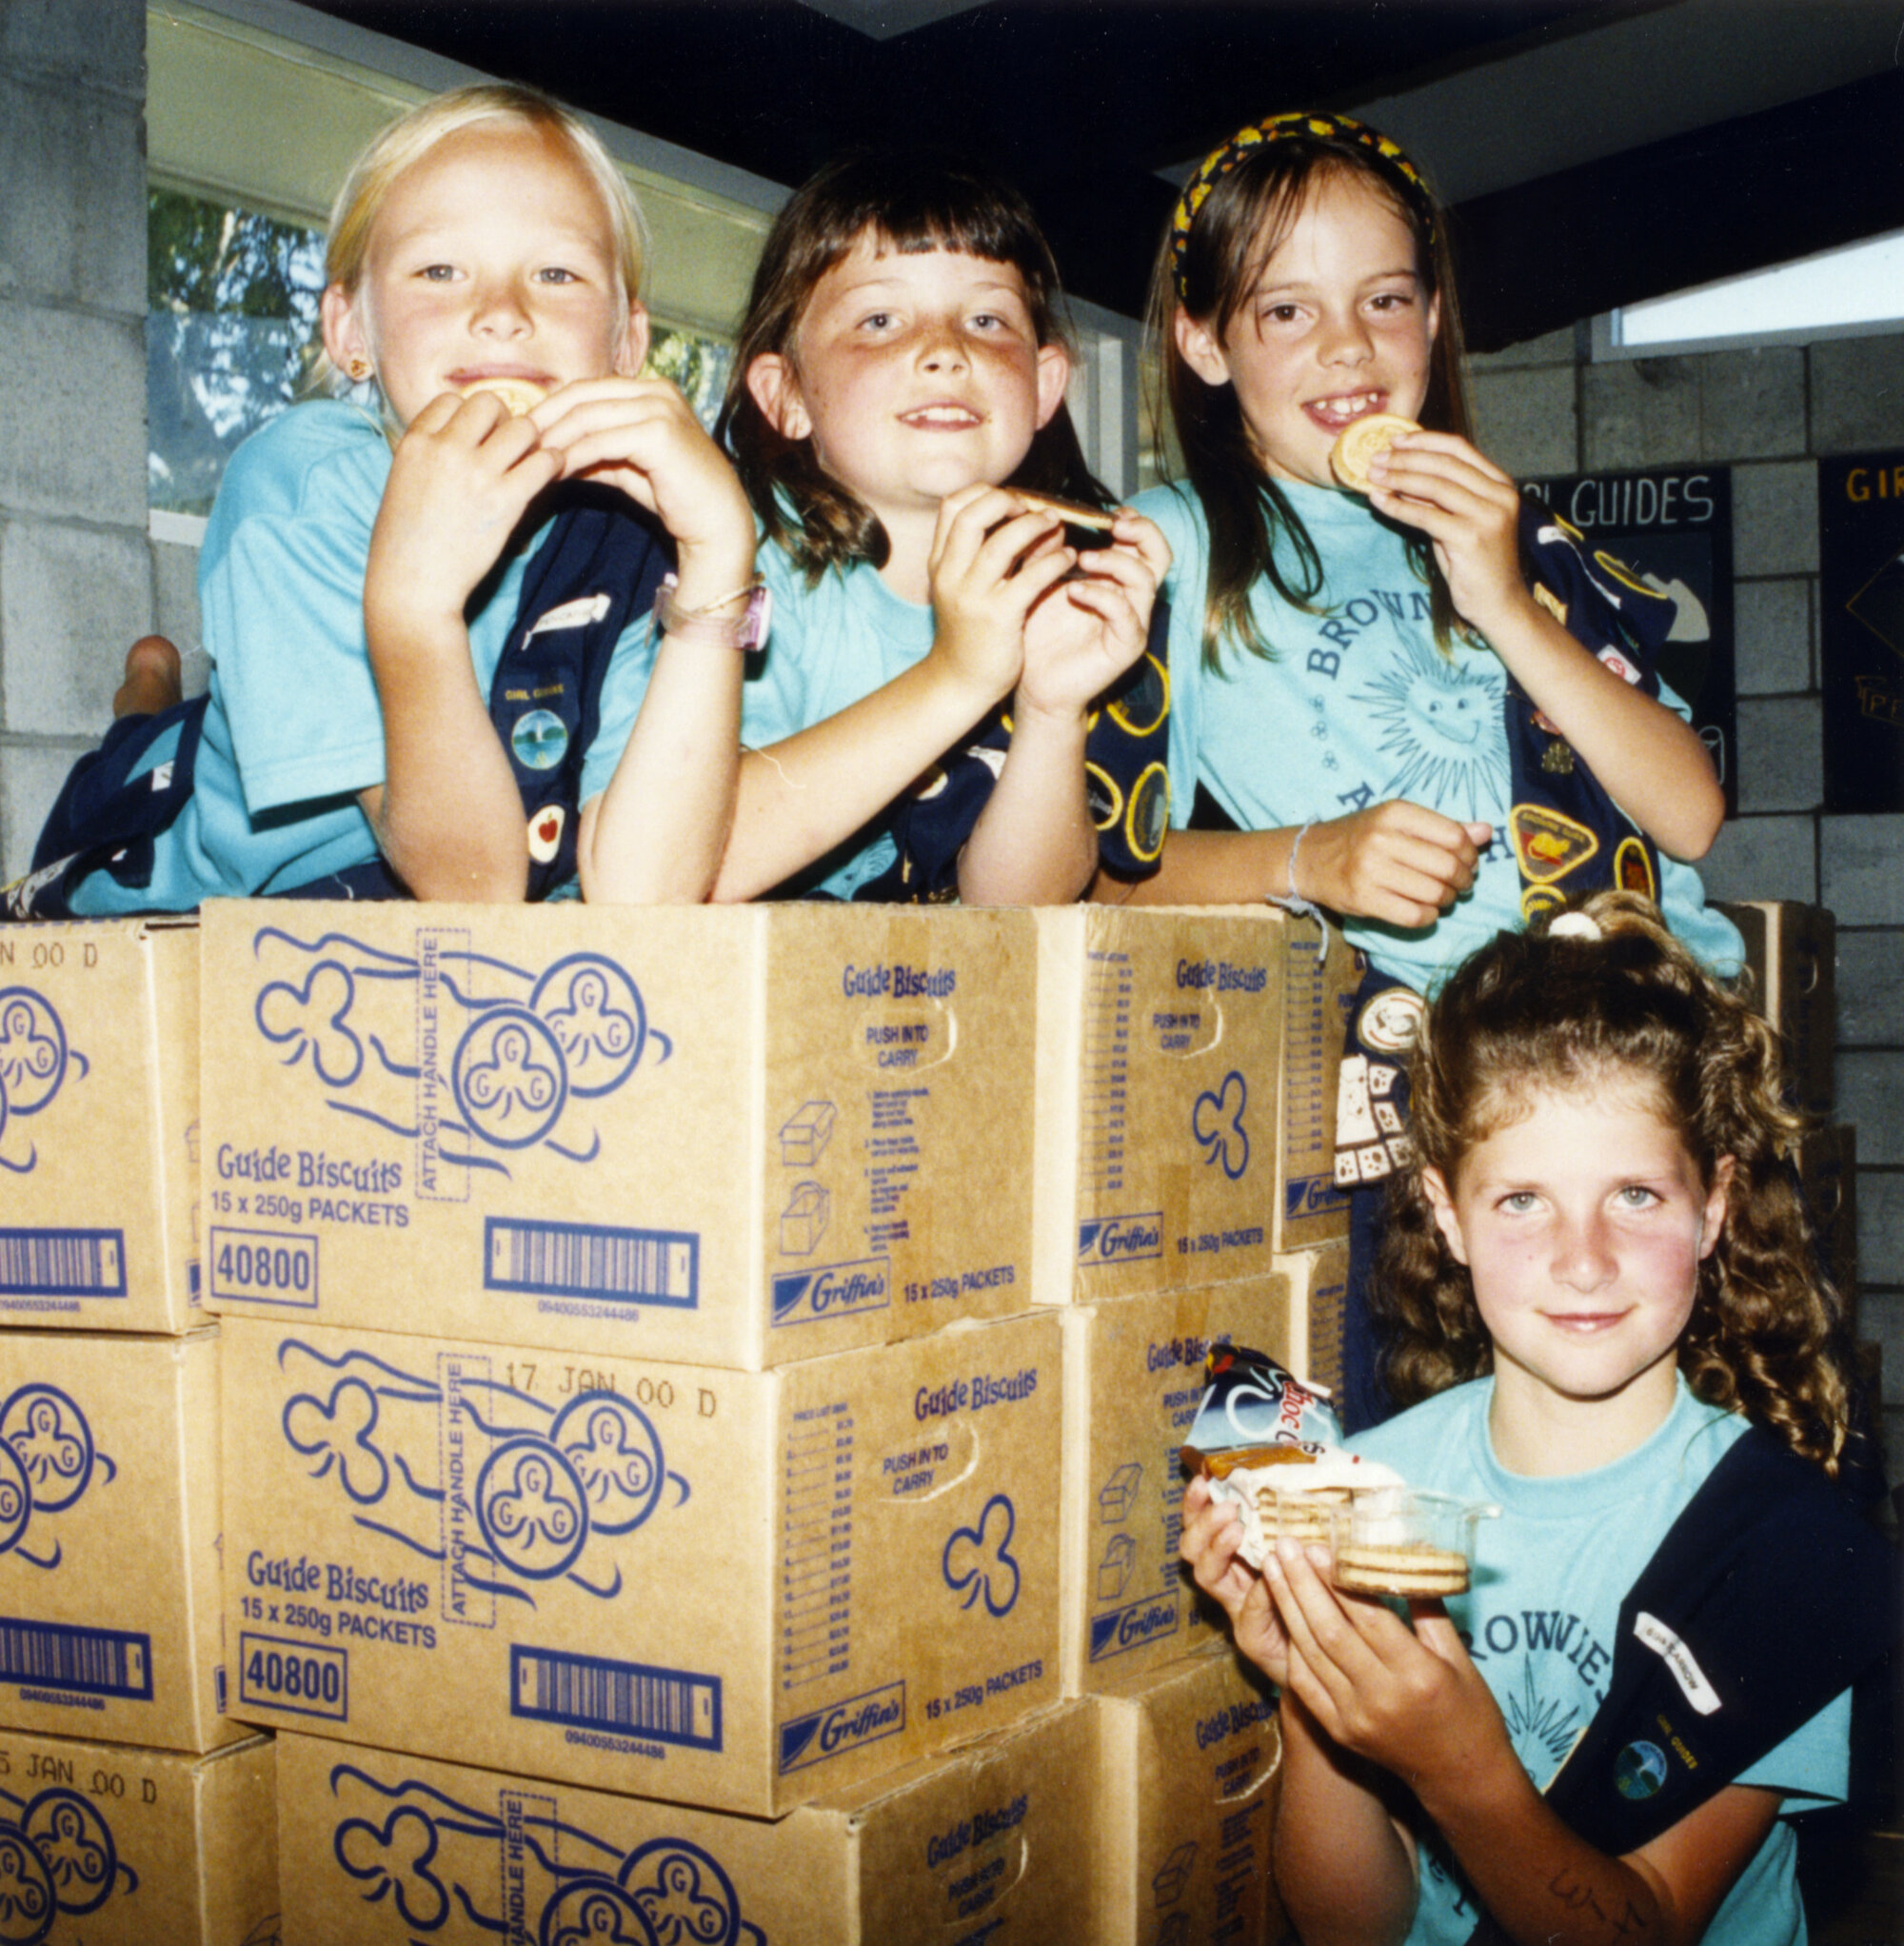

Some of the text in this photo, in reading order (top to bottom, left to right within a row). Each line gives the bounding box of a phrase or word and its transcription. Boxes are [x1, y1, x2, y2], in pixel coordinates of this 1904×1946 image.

[1571, 476, 1714, 527] GUIDES
[1306, 588, 1434, 680] BROWN
[843, 964, 955, 999] Guide Biscuits
[1177, 959, 1266, 992] Guide Biscuits
[866, 1026, 899, 1044] PUSH
[1153, 1014, 1178, 1029] PUSH
[1160, 1035, 1191, 1049] CARRY
[422, 938, 438, 1191] ATTACH HANDLE HERE
[878, 1050, 918, 1067] CARRY
[217, 1142, 402, 1194] Guide Biscuits
[211, 1190, 409, 1226] 15 x 250g PACKETS
[1221, 1227, 1263, 1247] PACKETS
[218, 1244, 309, 1290] 40800
[810, 1272, 884, 1312] Griffin's
[904, 1283, 917, 1301] 15
[931, 1278, 959, 1300] 250g
[962, 1265, 1015, 1292] PACKETS
[1147, 1338, 1182, 1372] Guide
[506, 1363, 716, 1418] 17 JAN 00 D
[915, 1369, 1037, 1421] Guide Biscuits
[447, 1363, 466, 1615] ATTACH HANDLE HERE
[883, 1453, 916, 1475] PUSH
[893, 1470, 935, 1496] CARRY
[248, 1550, 429, 1613] Guide Biscuits
[242, 1597, 437, 1648] 15 x 250g PACKETS
[247, 1650, 340, 1703] 40800
[1458, 1611, 1611, 1704] ROWNIE
[925, 1701, 941, 1719] 15
[955, 1685, 984, 1707] 250g
[986, 1660, 1043, 1696] PACKETS
[821, 1700, 900, 1751] Griffin's
[27, 1753, 73, 1784] JAN
[143, 1777, 157, 1804] D
[507, 1801, 524, 1860] HERE
